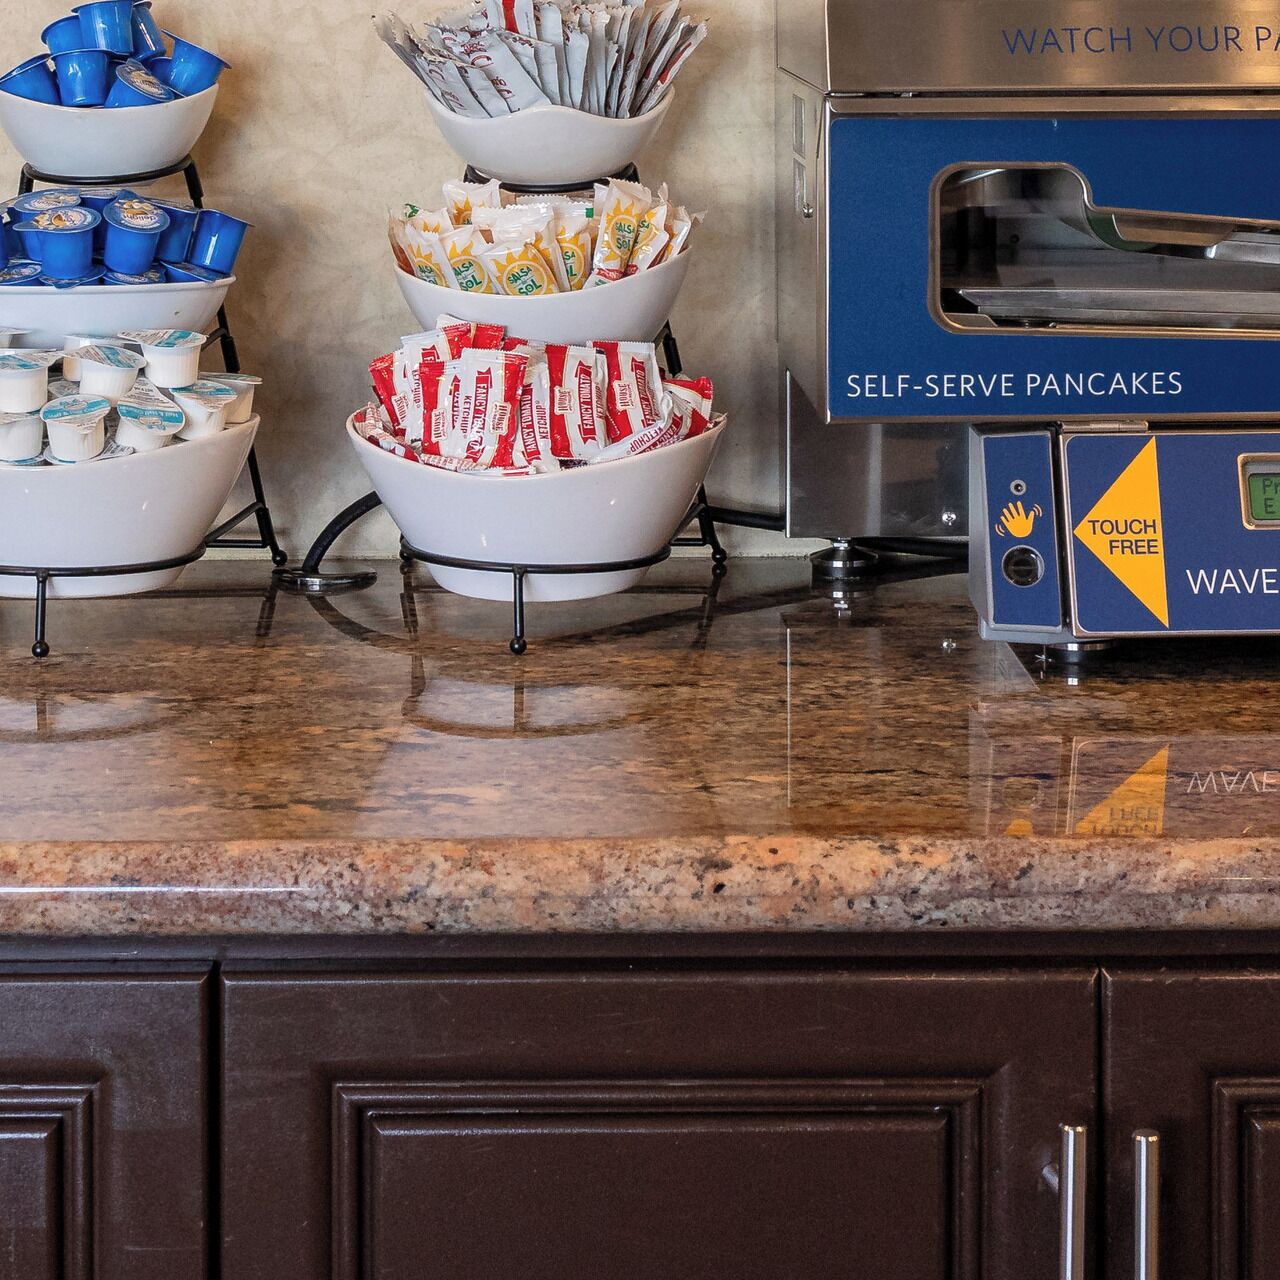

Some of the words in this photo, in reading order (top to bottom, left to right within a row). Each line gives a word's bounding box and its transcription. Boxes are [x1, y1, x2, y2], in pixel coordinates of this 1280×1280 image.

[1002, 26, 1133, 55] WATCH
[1145, 26, 1244, 53] YOUR
[507, 267, 532, 285] SALSA
[518, 279, 543, 296] SOL
[579, 374, 592, 402] TOMATO
[617, 383, 630, 407] HOUSE
[636, 369, 649, 398] TOMATO
[847, 373, 1015, 398] SELF-SERVE
[1026, 371, 1183, 397] PANCAKES
[474, 383, 488, 414] FANCY
[521, 394, 533, 423] TOMATO
[557, 389, 568, 411] HOUSE
[641, 398, 655, 424] FANCY
[434, 411, 443, 439] HOUSE
[495, 404, 508, 432] HOUSE
[582, 403, 595, 429] FANCY
[1264, 497, 1275, 515] E
[1088, 518, 1157, 536] TOUCH
[1109, 538, 1159, 555] FREE
[1186, 568, 1280, 595] WAVE
